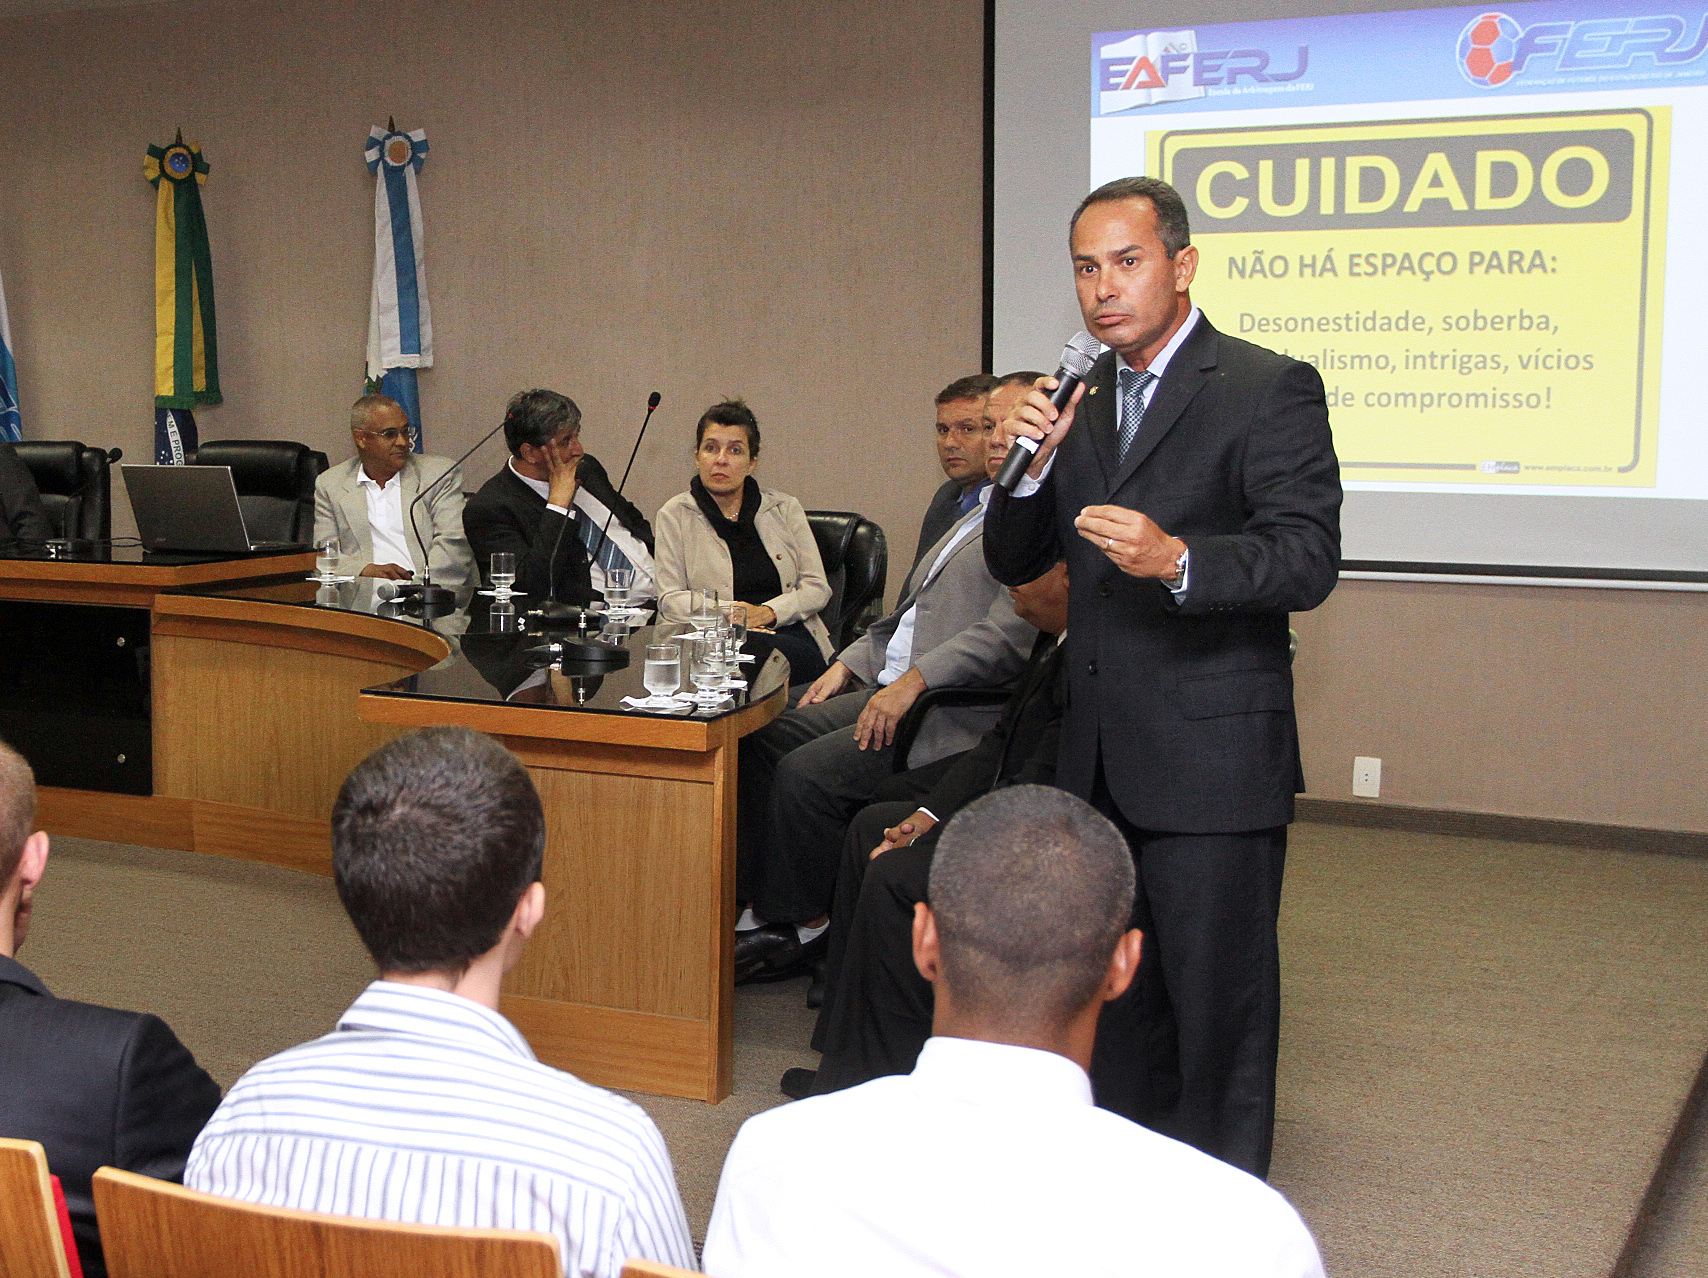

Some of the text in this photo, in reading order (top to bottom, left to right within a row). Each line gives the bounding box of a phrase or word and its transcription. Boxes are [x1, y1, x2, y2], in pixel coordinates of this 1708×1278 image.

[1100, 45, 1309, 92] EAFERJ
[1195, 145, 1611, 220] CUIDADO
[1227, 247, 1558, 283] NÃO HÁ ESPAÇO PARA:
[1238, 308, 1559, 336] Desonestidade, soberba,
[1405, 348, 1510, 376] intrigas,
[1518, 348, 1595, 371] vícios
[1327, 386, 1553, 414] de compromisso!
